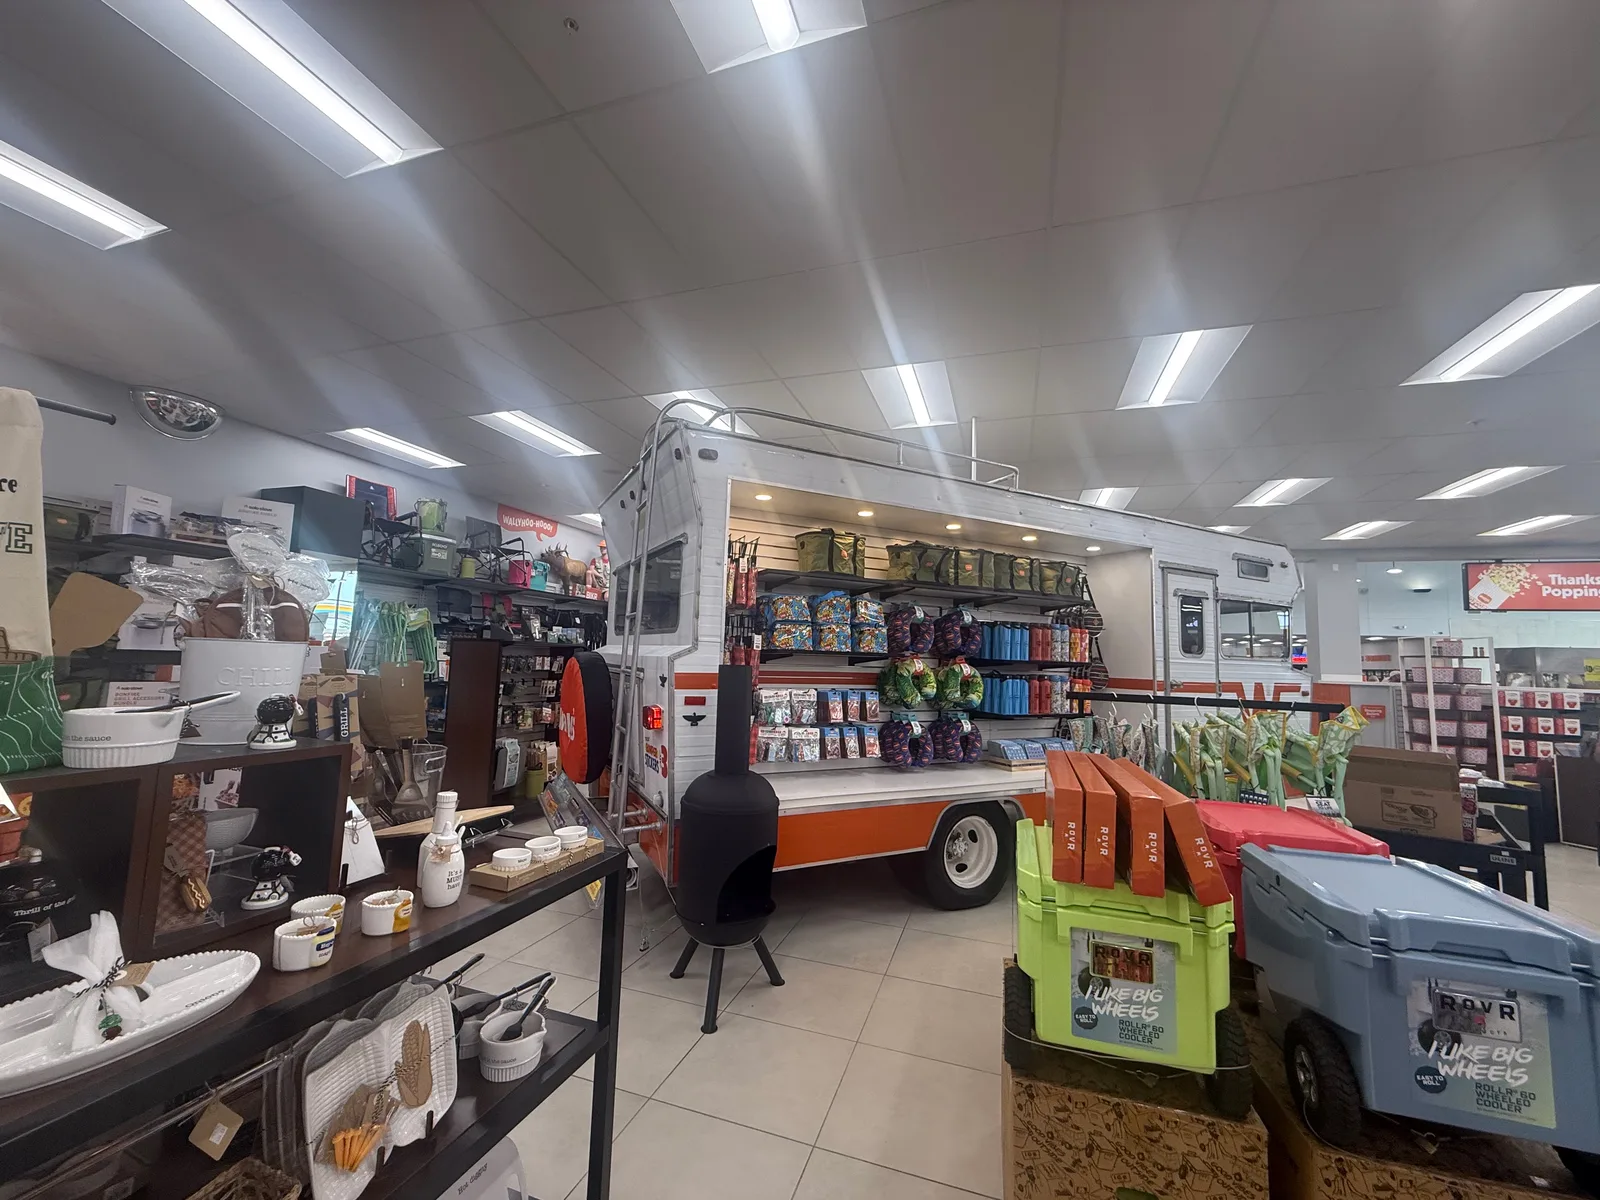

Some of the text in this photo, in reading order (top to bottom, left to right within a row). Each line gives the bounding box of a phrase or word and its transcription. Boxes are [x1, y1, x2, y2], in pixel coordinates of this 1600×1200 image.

[1548, 573, 1600, 585] Thanks
[1542, 585, 1600, 599] Poppin
[217, 667, 294, 687] CHILL
[340, 707, 350, 738] GRILL
[1067, 821, 1076, 850] ROVR
[1100, 826, 1109, 856] ROVR
[1148, 832, 1157, 863] ROVR
[1194, 837, 1214, 869] ROVR
[14, 907, 41, 917] Thrill
[43, 903, 53, 911] of
[54, 900, 66, 908] the
[1095, 945, 1150, 965] ROVR
[1085, 984, 1163, 1004] I LIKE BIG
[1091, 1001, 1159, 1022] WHEELS
[1440, 994, 1516, 1021] ROVR
[1119, 1026, 1160, 1039] WHEELED
[1119, 1032, 1153, 1045] COOLER
[1428, 1039, 1533, 1065] I LIKE BIG
[1437, 1061, 1529, 1088] WHEELS
[1475, 1090, 1531, 1108] WHEELED
[1476, 1098, 1522, 1114] COOLER
[1520, 1091, 1536, 1101] 60
[458, 1181, 469, 1195] Hot
